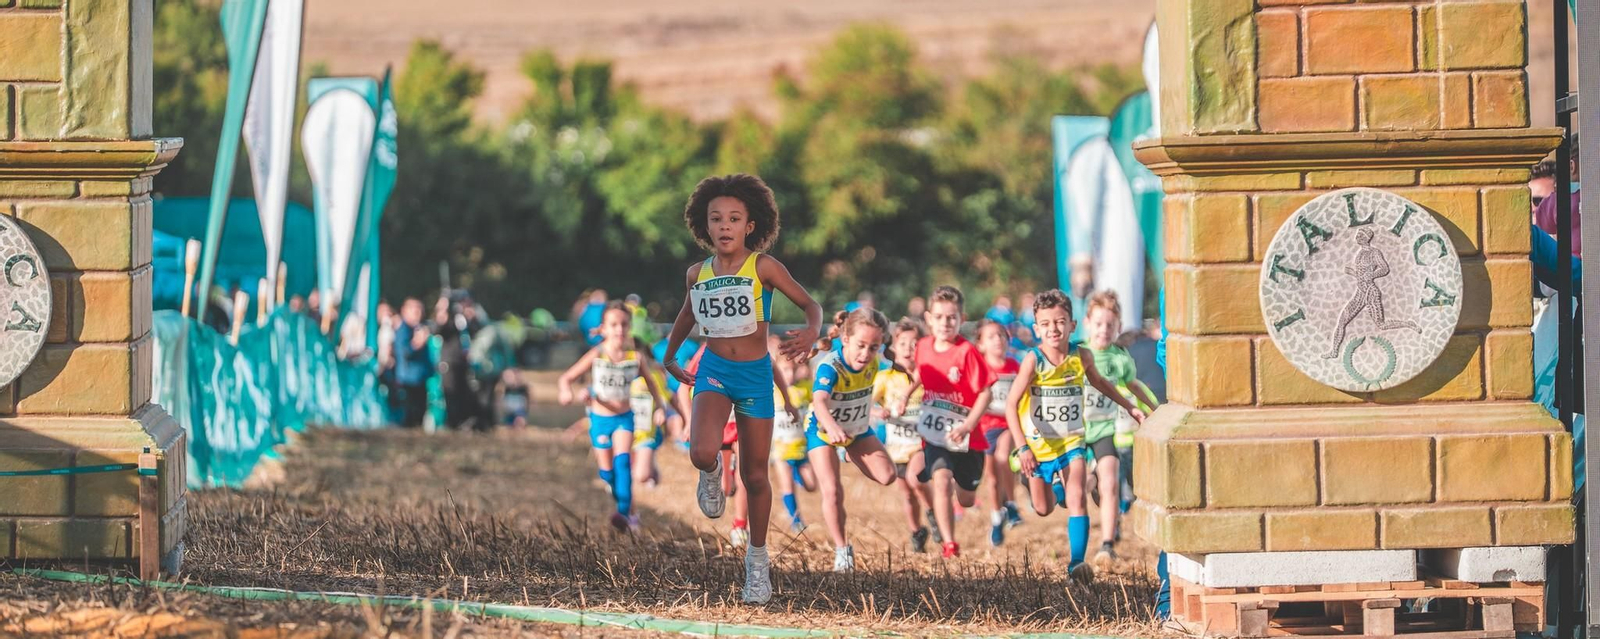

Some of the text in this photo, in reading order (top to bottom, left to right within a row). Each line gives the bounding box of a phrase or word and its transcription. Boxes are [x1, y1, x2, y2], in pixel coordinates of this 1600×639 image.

[1269, 193, 1457, 332] ITALICA
[0, 224, 42, 333] CA
[707, 278, 736, 288] ITALICA
[698, 295, 751, 318] 4588
[1086, 394, 1113, 409] 587
[831, 403, 868, 422] 4571
[1034, 404, 1080, 422] 4583
[894, 424, 920, 438] 46
[923, 413, 964, 431] 463
